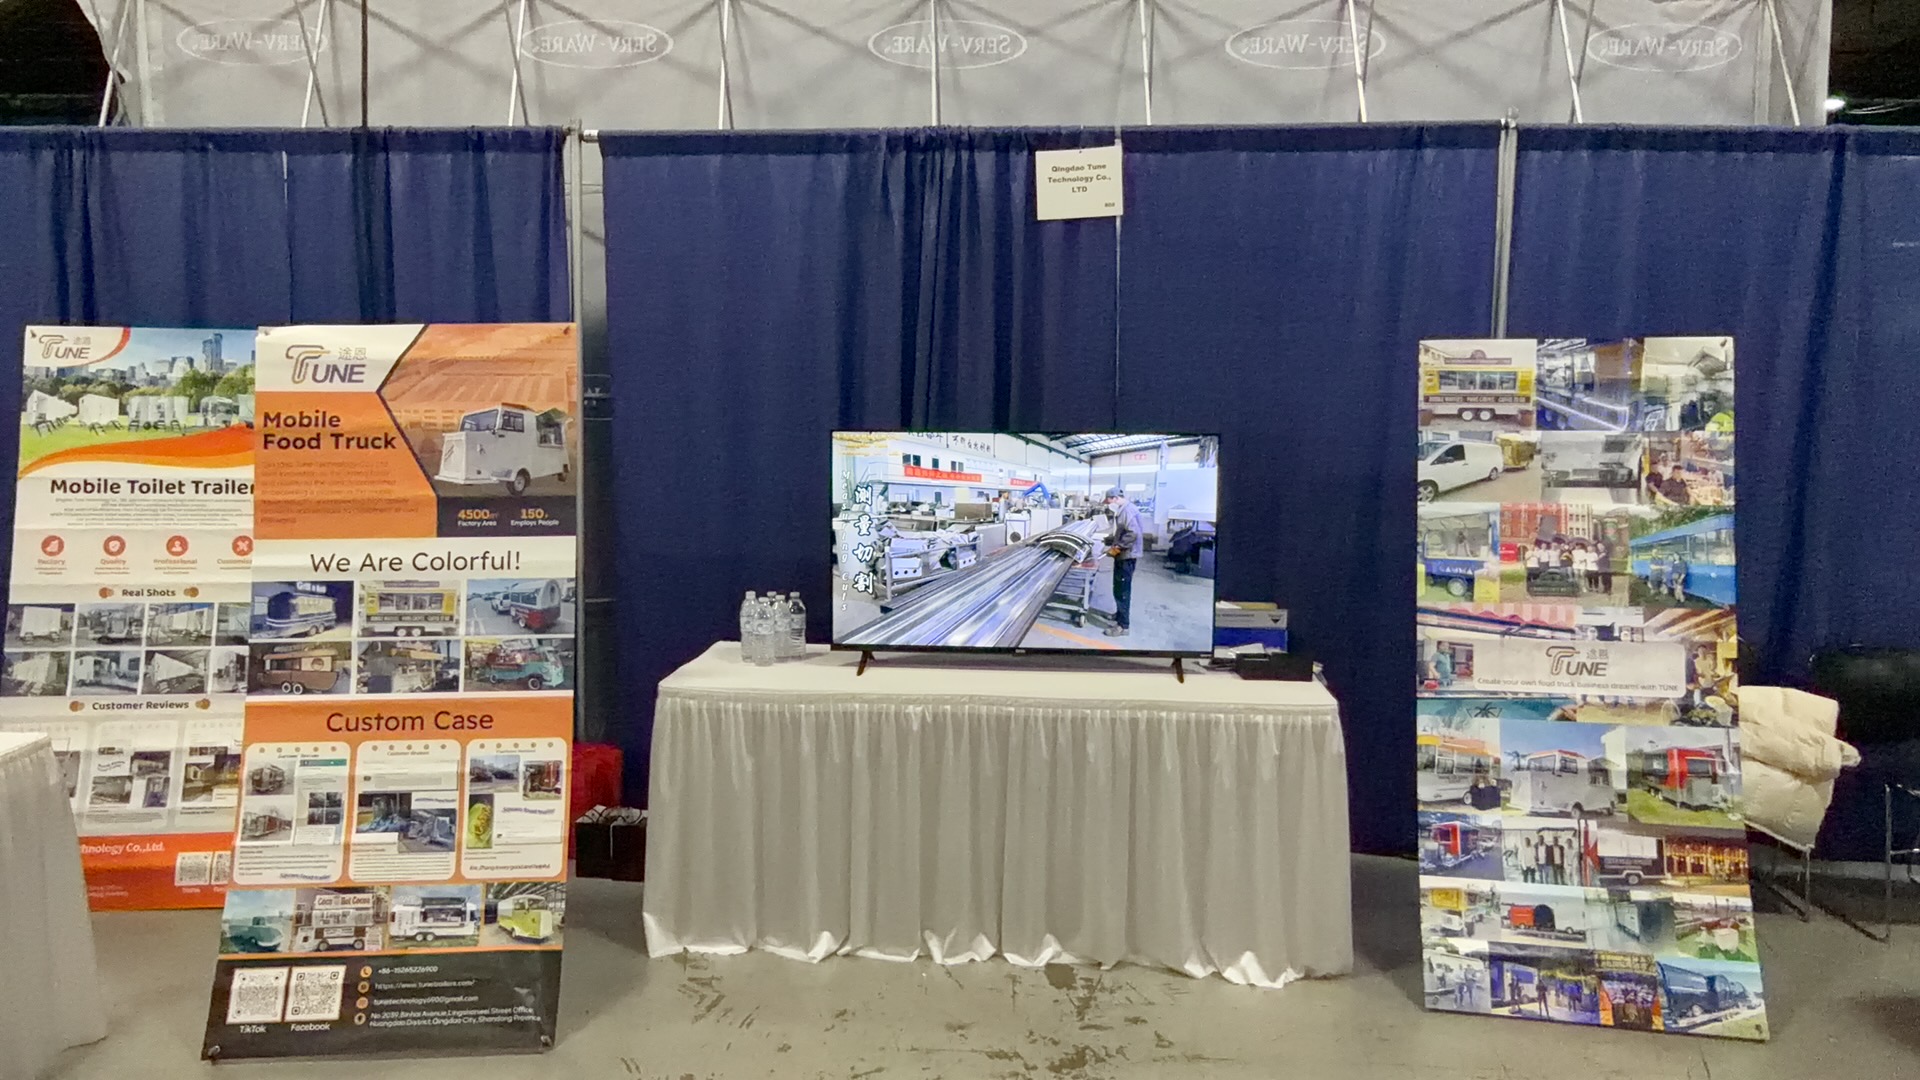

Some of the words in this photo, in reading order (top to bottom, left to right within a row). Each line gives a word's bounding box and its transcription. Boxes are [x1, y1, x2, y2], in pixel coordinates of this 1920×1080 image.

[1051, 165, 1085, 173] Qingdao
[1087, 163, 1107, 171] Tune
[1047, 176, 1094, 184] Technology
[39, 334, 91, 359] TUNE
[285, 344, 367, 384] TUNE
[263, 409, 341, 428] Mobile
[263, 432, 321, 450] Food
[330, 432, 397, 450] Truck
[50, 478, 121, 495] Mobile
[127, 478, 186, 495] Toilet
[538, 519, 559, 527] People
[852, 485, 875, 595] 测量切割
[310, 553, 350, 573] We
[359, 552, 403, 572] Are
[412, 550, 520, 571] Colorful!
[122, 588, 144, 597] Real
[146, 588, 177, 597] Shots
[1546, 645, 1608, 677] TUNE
[1477, 677, 1501, 685] Create
[1502, 679, 1519, 687] your
[1538, 679, 1555, 687] food
[1556, 680, 1575, 688] truck
[92, 701, 144, 711] Customer
[146, 700, 190, 710] Reviews
[326, 712, 425, 733] Custom
[434, 710, 494, 730] Case
[80, 844, 124, 855] hnology
[239, 1025, 267, 1033] TikTok
[290, 1023, 331, 1032] Facebook
